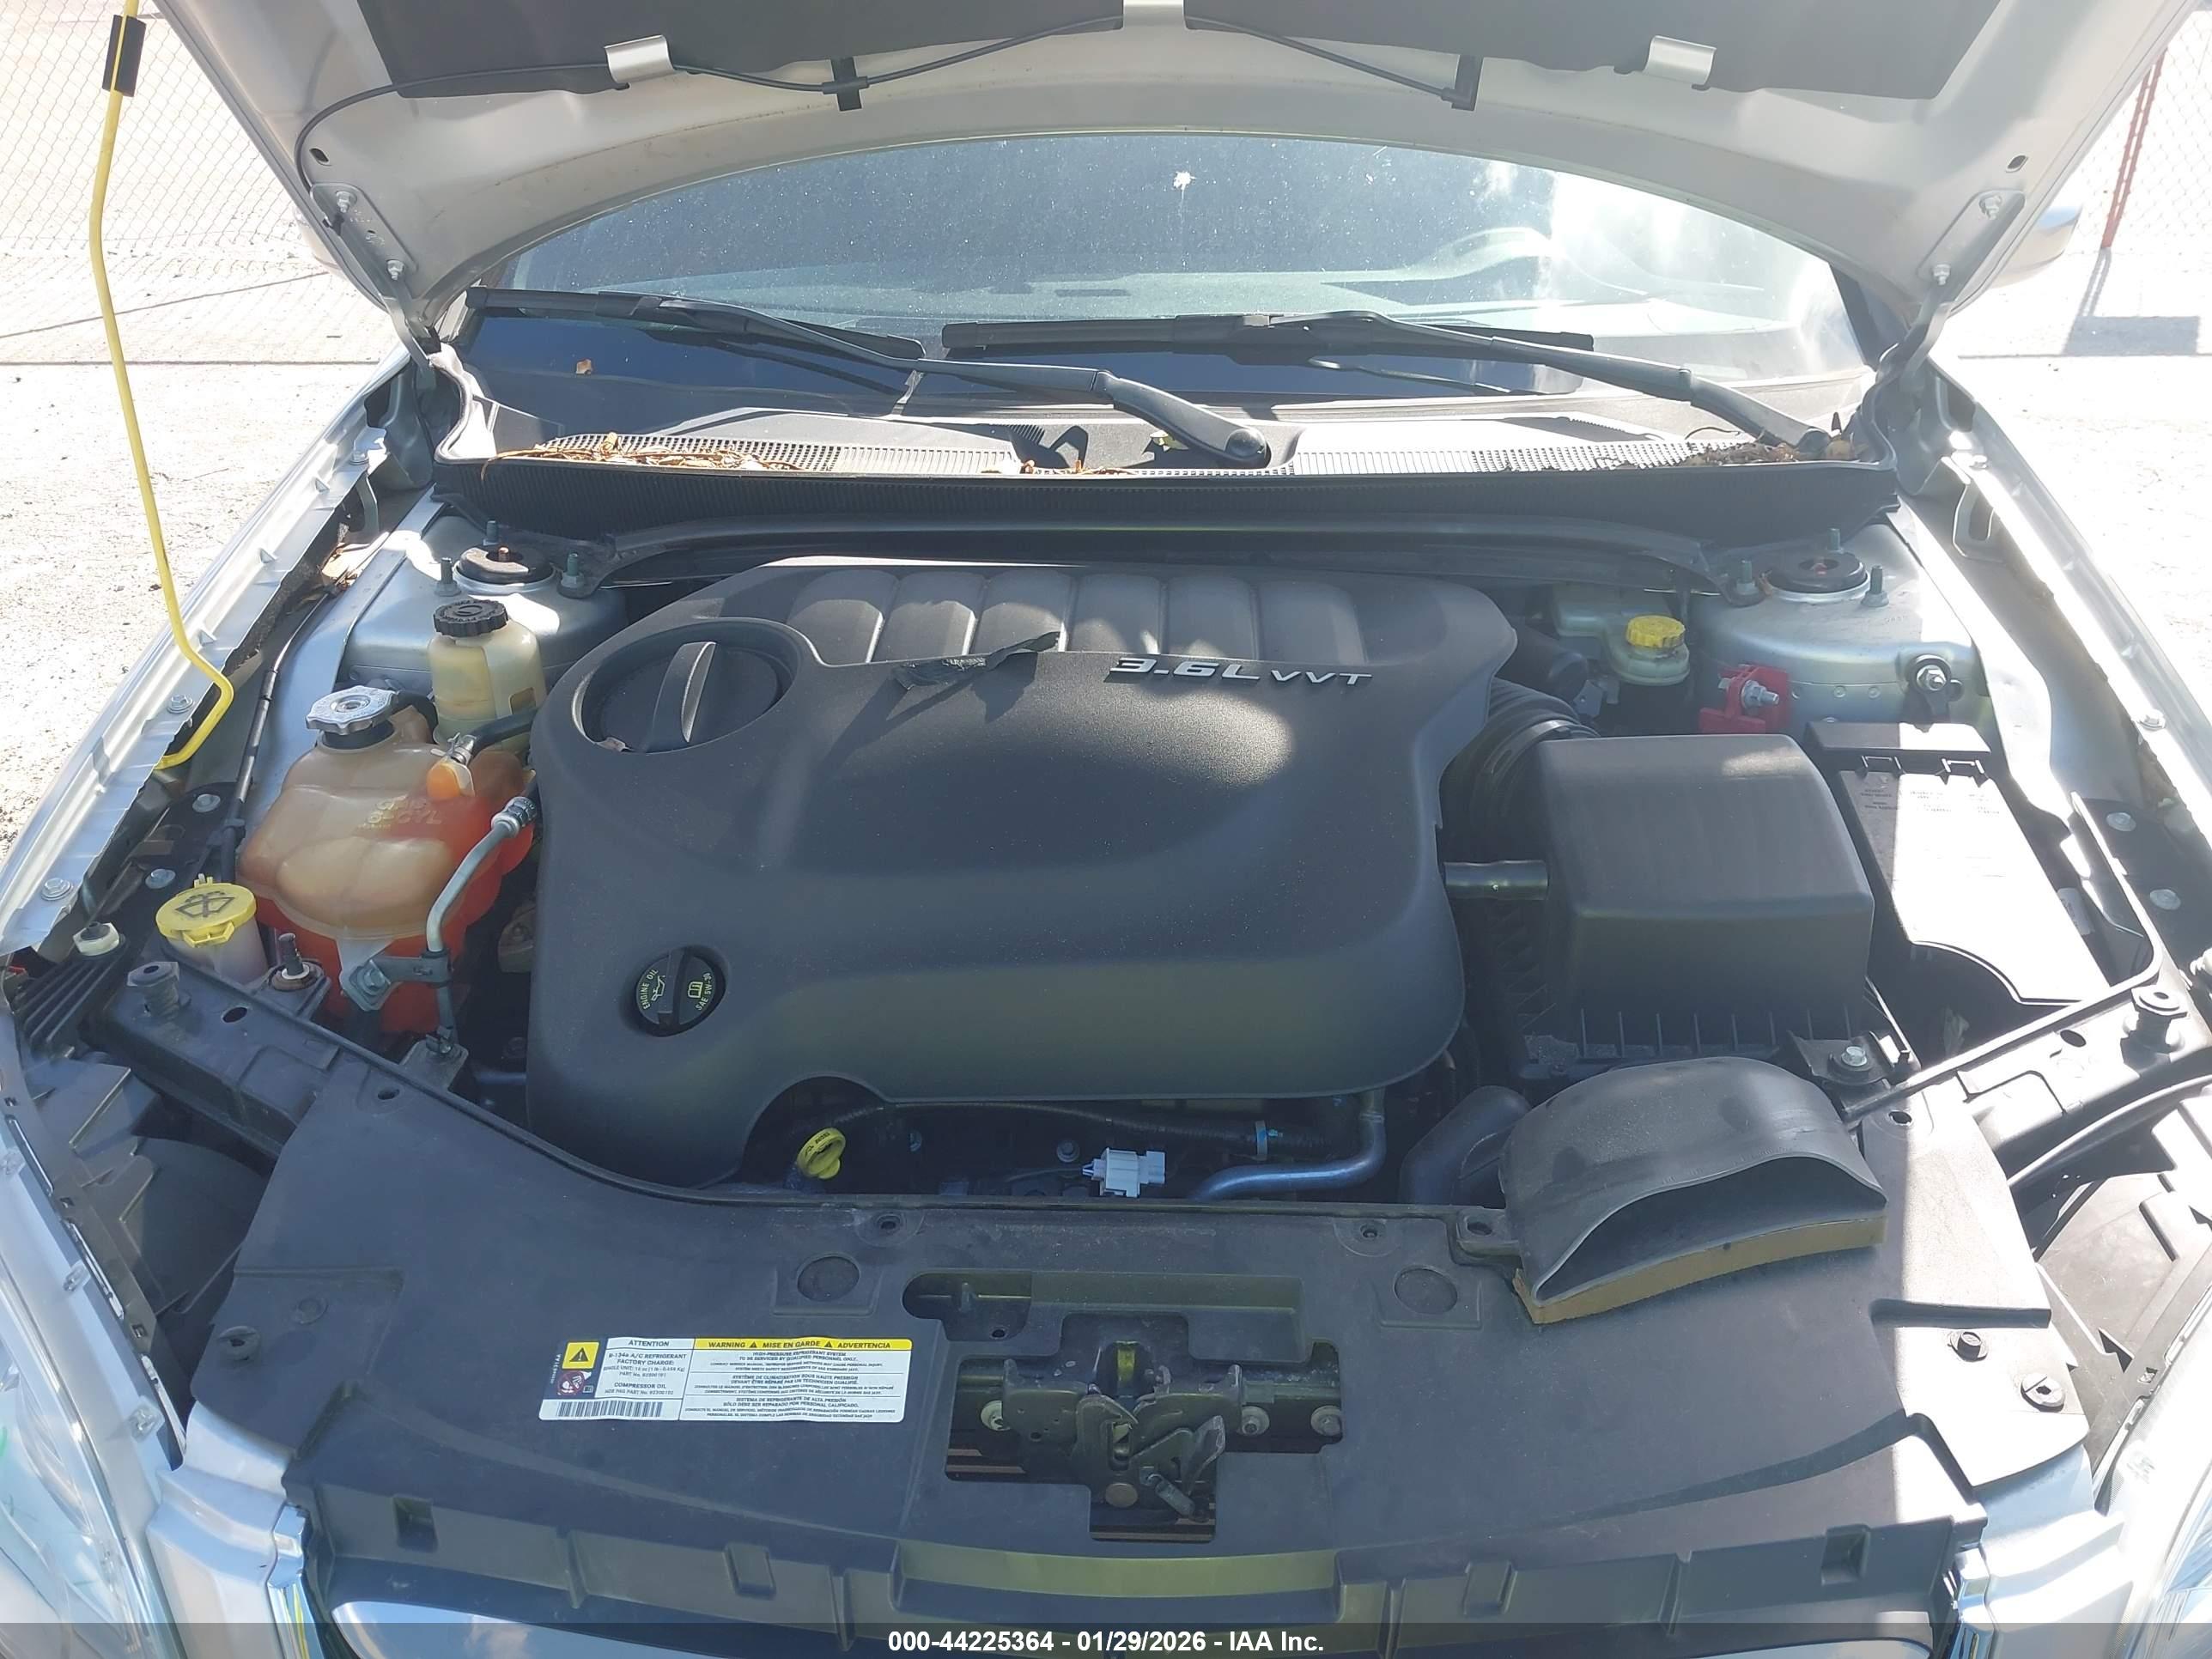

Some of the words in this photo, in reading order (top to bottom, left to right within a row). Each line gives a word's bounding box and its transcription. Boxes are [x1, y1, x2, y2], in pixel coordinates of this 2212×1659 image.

[1109, 657, 1261, 680] 3.6L
[1271, 670, 1372, 685] VVT
[640, 982, 651, 1010] ENGINE
[646, 969, 659, 980] OIL
[695, 996, 708, 1011] SAE
